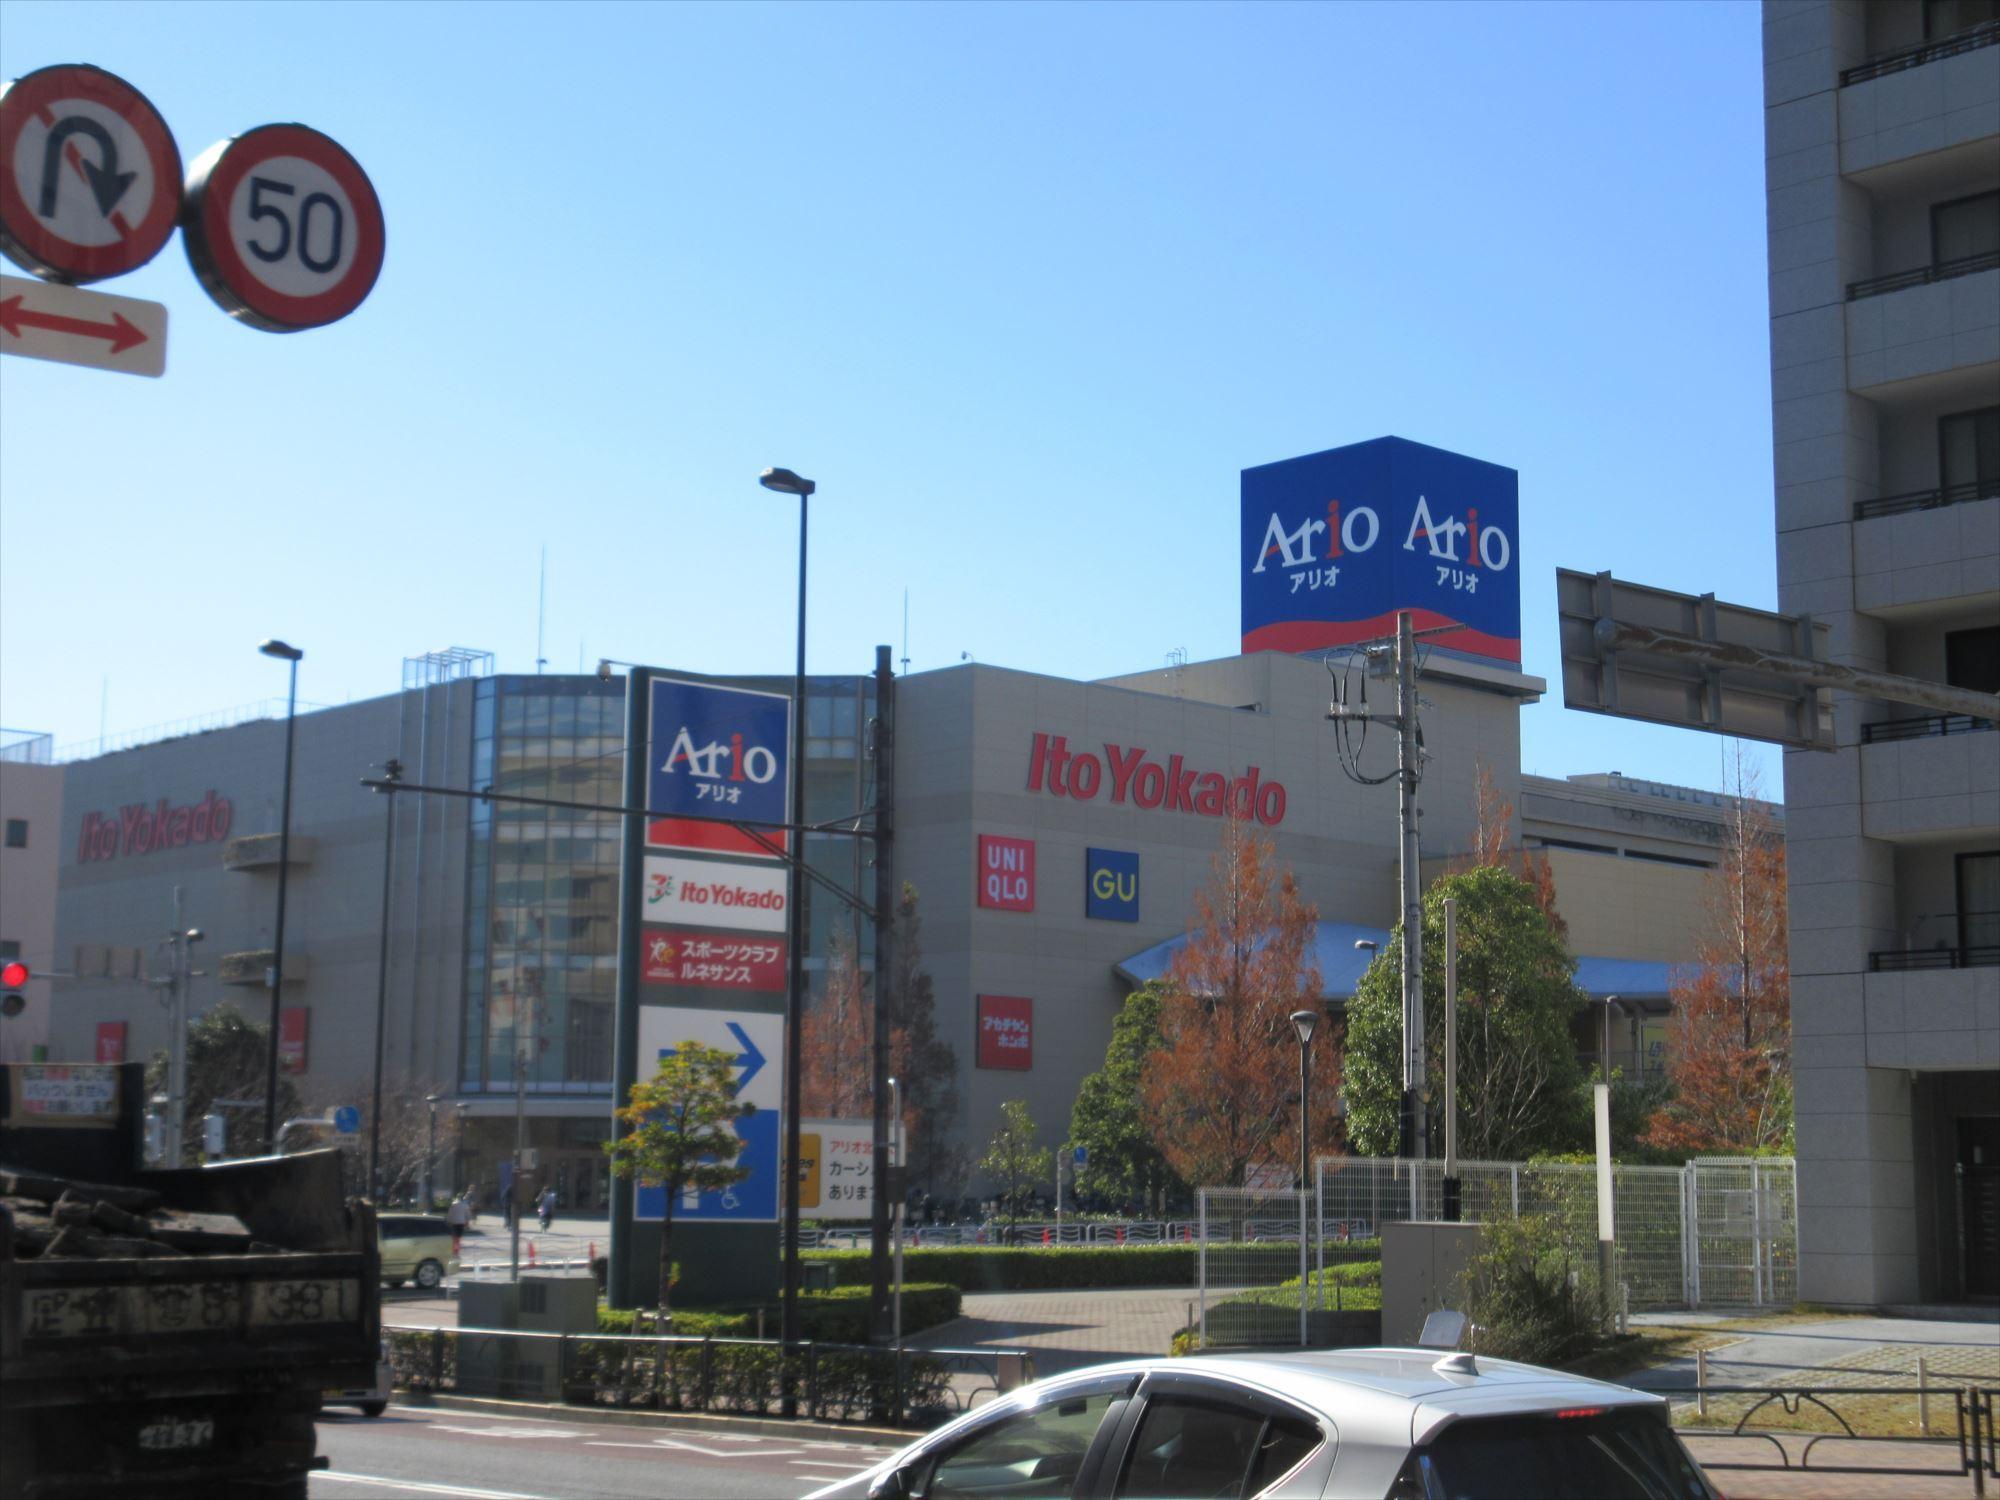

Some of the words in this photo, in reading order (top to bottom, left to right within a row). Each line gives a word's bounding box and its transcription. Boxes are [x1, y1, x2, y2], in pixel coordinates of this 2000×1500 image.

[246, 175, 343, 274] 50
[1252, 499, 1380, 574] Ario
[1403, 495, 1510, 572] Ario
[1290, 566, 1340, 594] アリオ
[1436, 566, 1479, 593] アリオ
[661, 727, 777, 785] Ario
[695, 782, 742, 804] アリオ
[987, 844, 1025, 872] UNI
[987, 875, 1028, 903] QLO
[1092, 869, 1136, 902] GU
[681, 940, 779, 964] スポーツクラブ
[681, 963, 751, 983] ルネサンス
[829, 1184, 873, 1201] ありま
